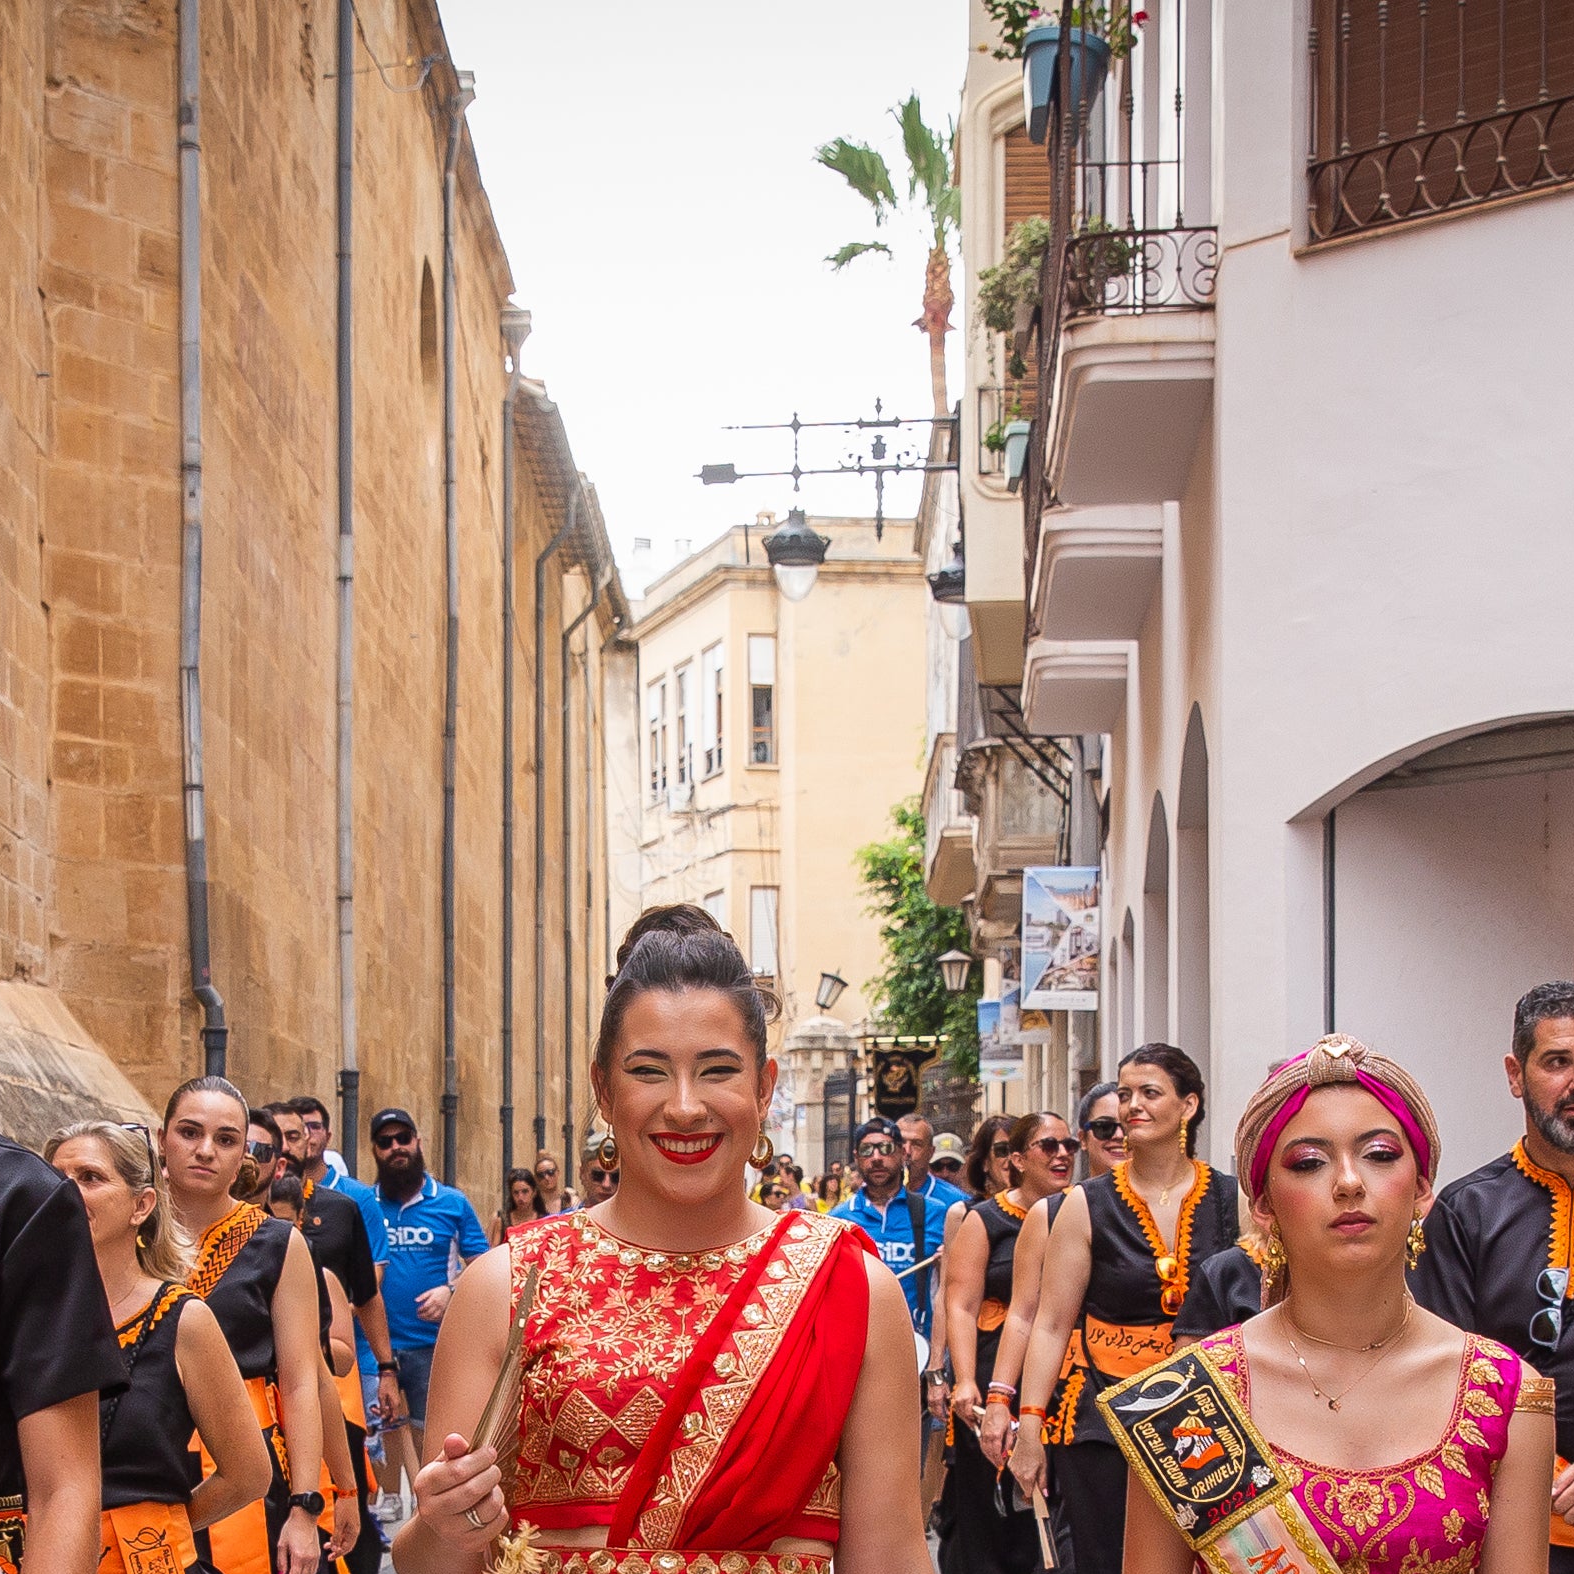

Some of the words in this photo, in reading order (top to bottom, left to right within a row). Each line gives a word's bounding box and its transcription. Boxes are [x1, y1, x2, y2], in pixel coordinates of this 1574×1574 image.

[1139, 1421, 1167, 1456] VIEJOS
[1193, 1391, 1218, 1418] ABEN
[1214, 1425, 1244, 1461] MOHOR
[1159, 1455, 1189, 1489] MOROS
[1190, 1460, 1242, 1500] ORIHUELA
[1206, 1481, 1258, 1527] 2024
